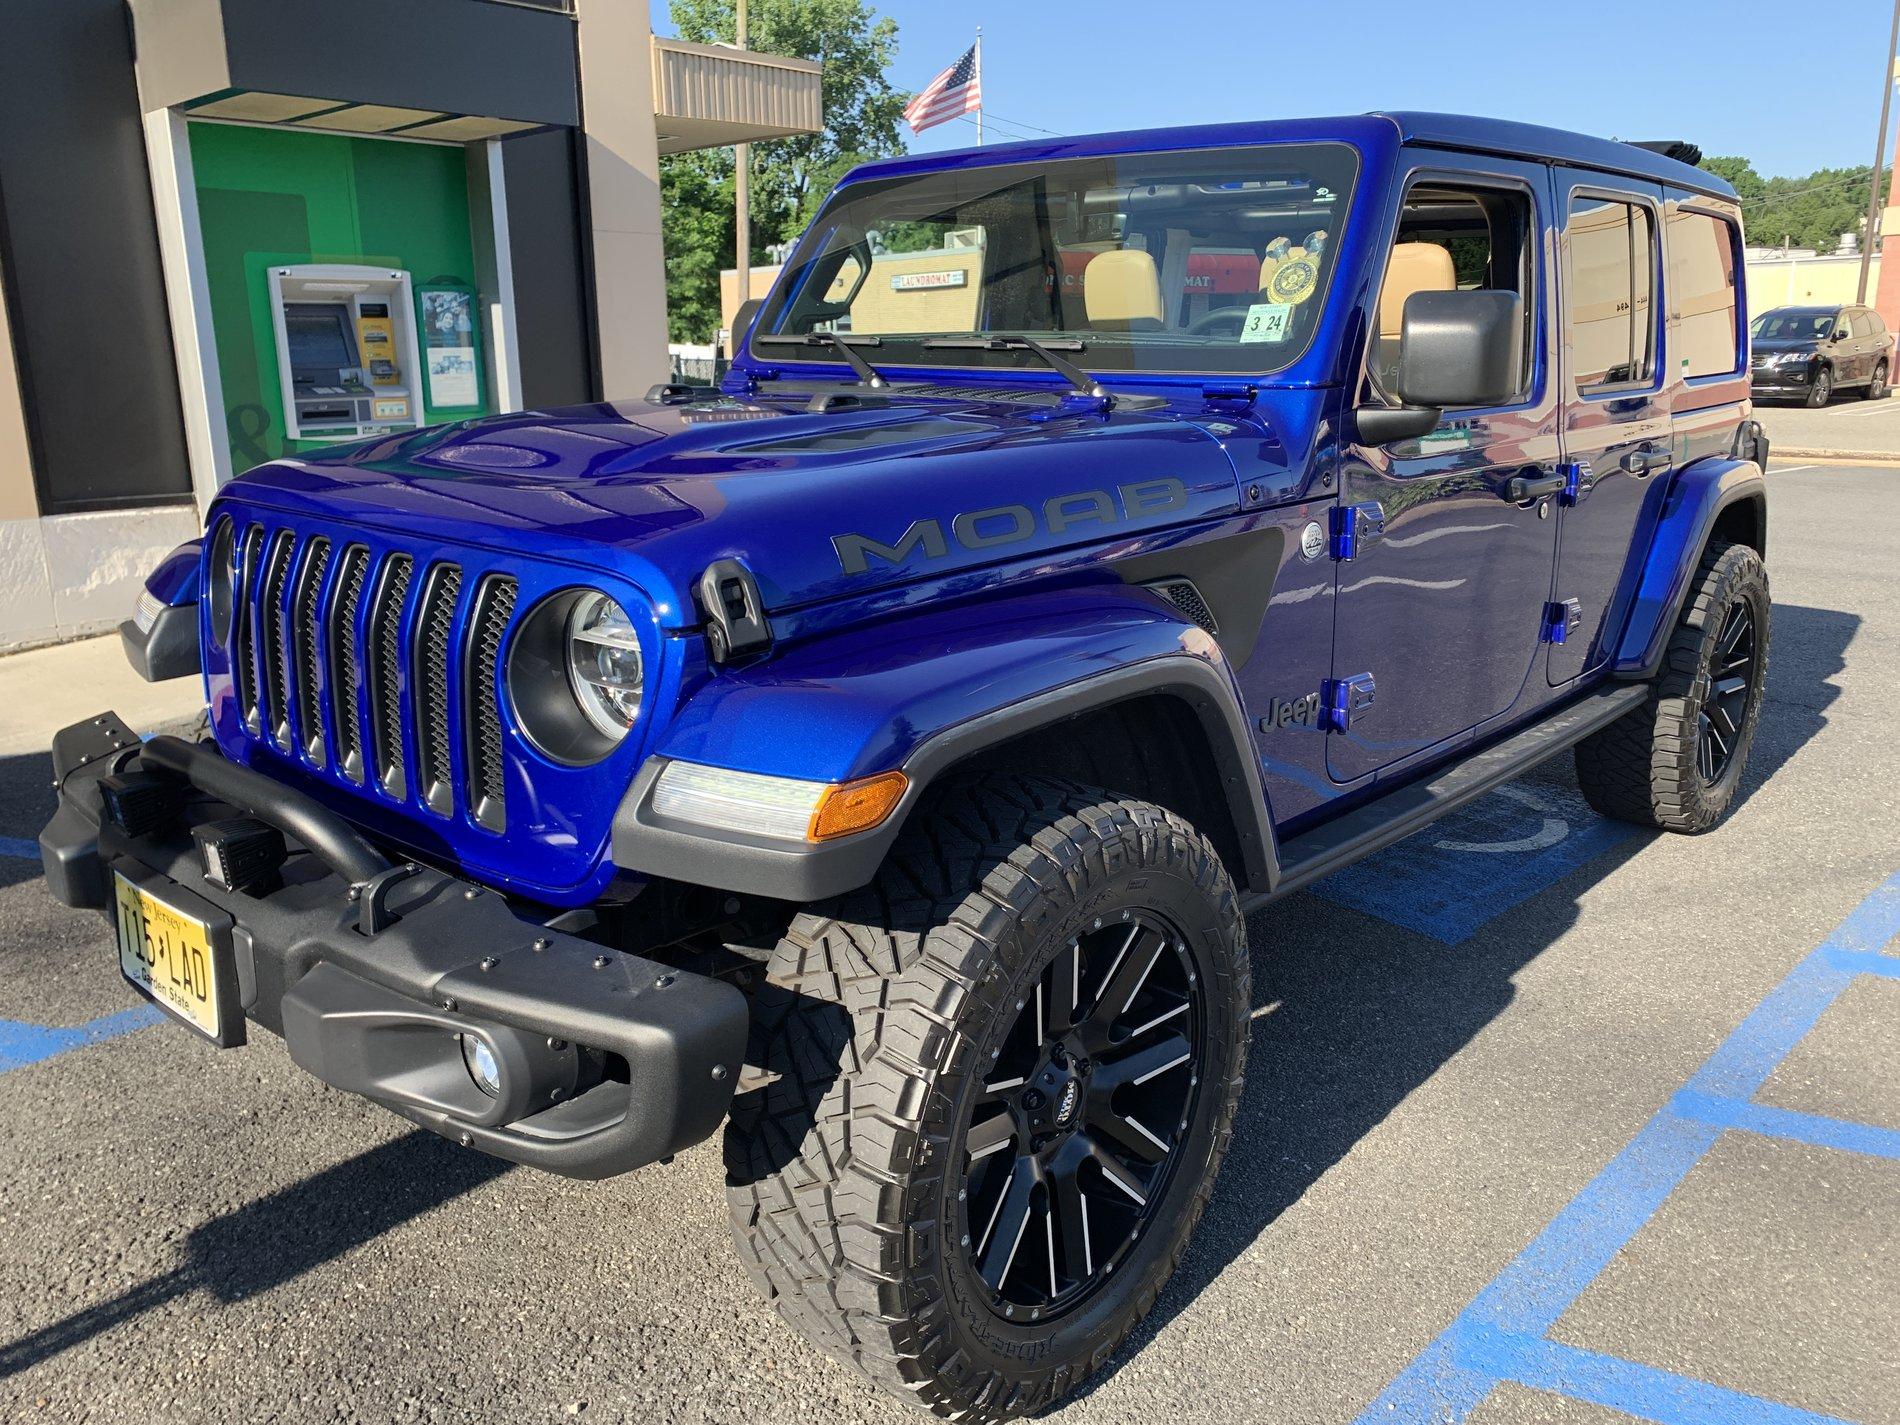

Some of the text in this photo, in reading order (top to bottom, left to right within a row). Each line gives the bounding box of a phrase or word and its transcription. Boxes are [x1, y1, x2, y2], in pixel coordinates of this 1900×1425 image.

[901, 273, 951, 287] LAUNDROMAT
[1250, 315, 1283, 331] 3 24
[829, 476, 1188, 576] MOAB
[1259, 692, 1321, 733] Jeep
[133, 889, 181, 934] New Jersey
[141, 967, 190, 1011] Garden State
